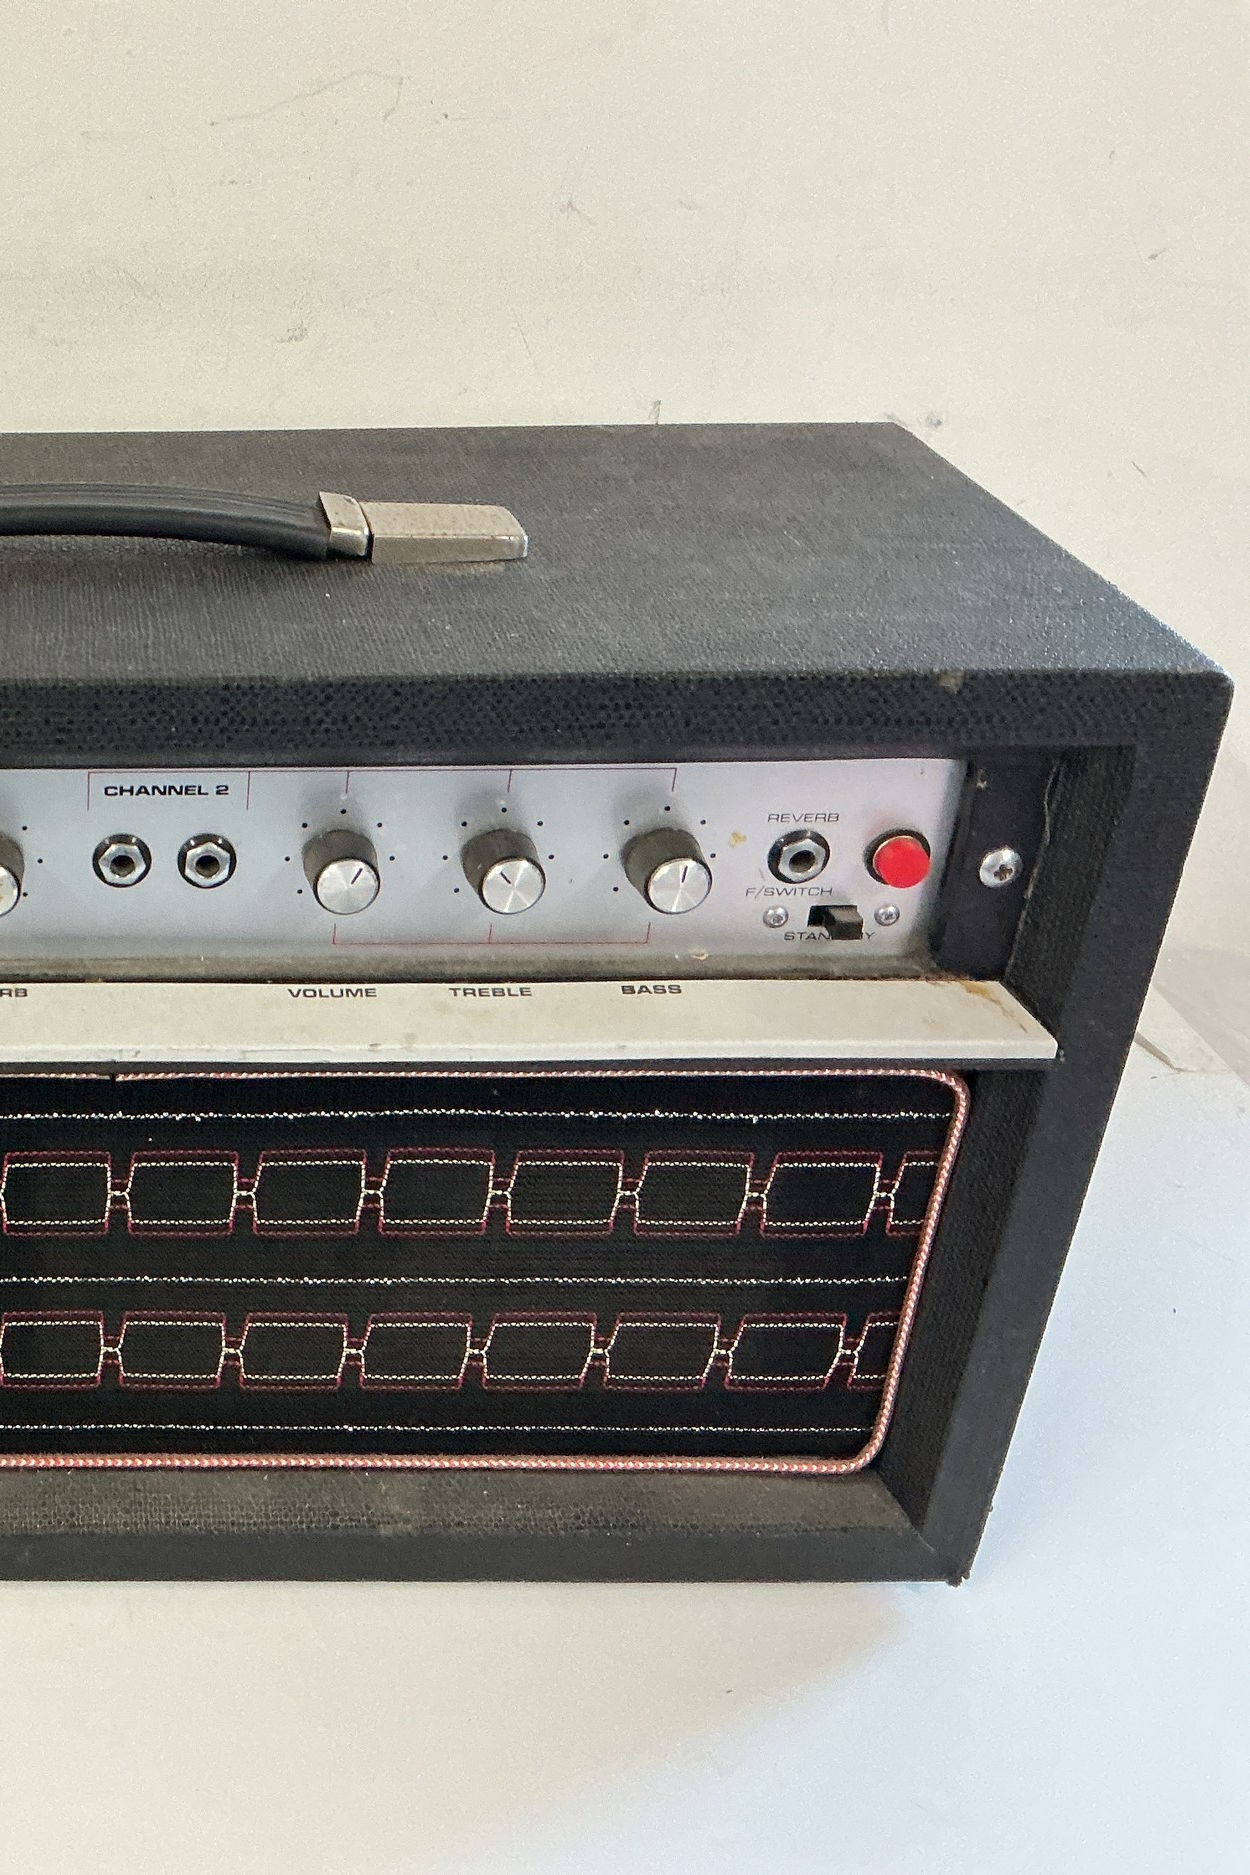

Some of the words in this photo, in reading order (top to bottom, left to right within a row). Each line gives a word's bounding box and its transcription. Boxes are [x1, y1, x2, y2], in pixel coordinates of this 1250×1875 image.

[104, 784, 209, 797] CHANNEL
[215, 784, 230, 796] 2
[767, 812, 840, 823] REVERB
[745, 885, 833, 899] F/SWITCH
[784, 931, 875, 942] STANY
[287, 987, 378, 998] VOLUME
[449, 986, 534, 997] TREBLE
[621, 984, 682, 995] BASS
